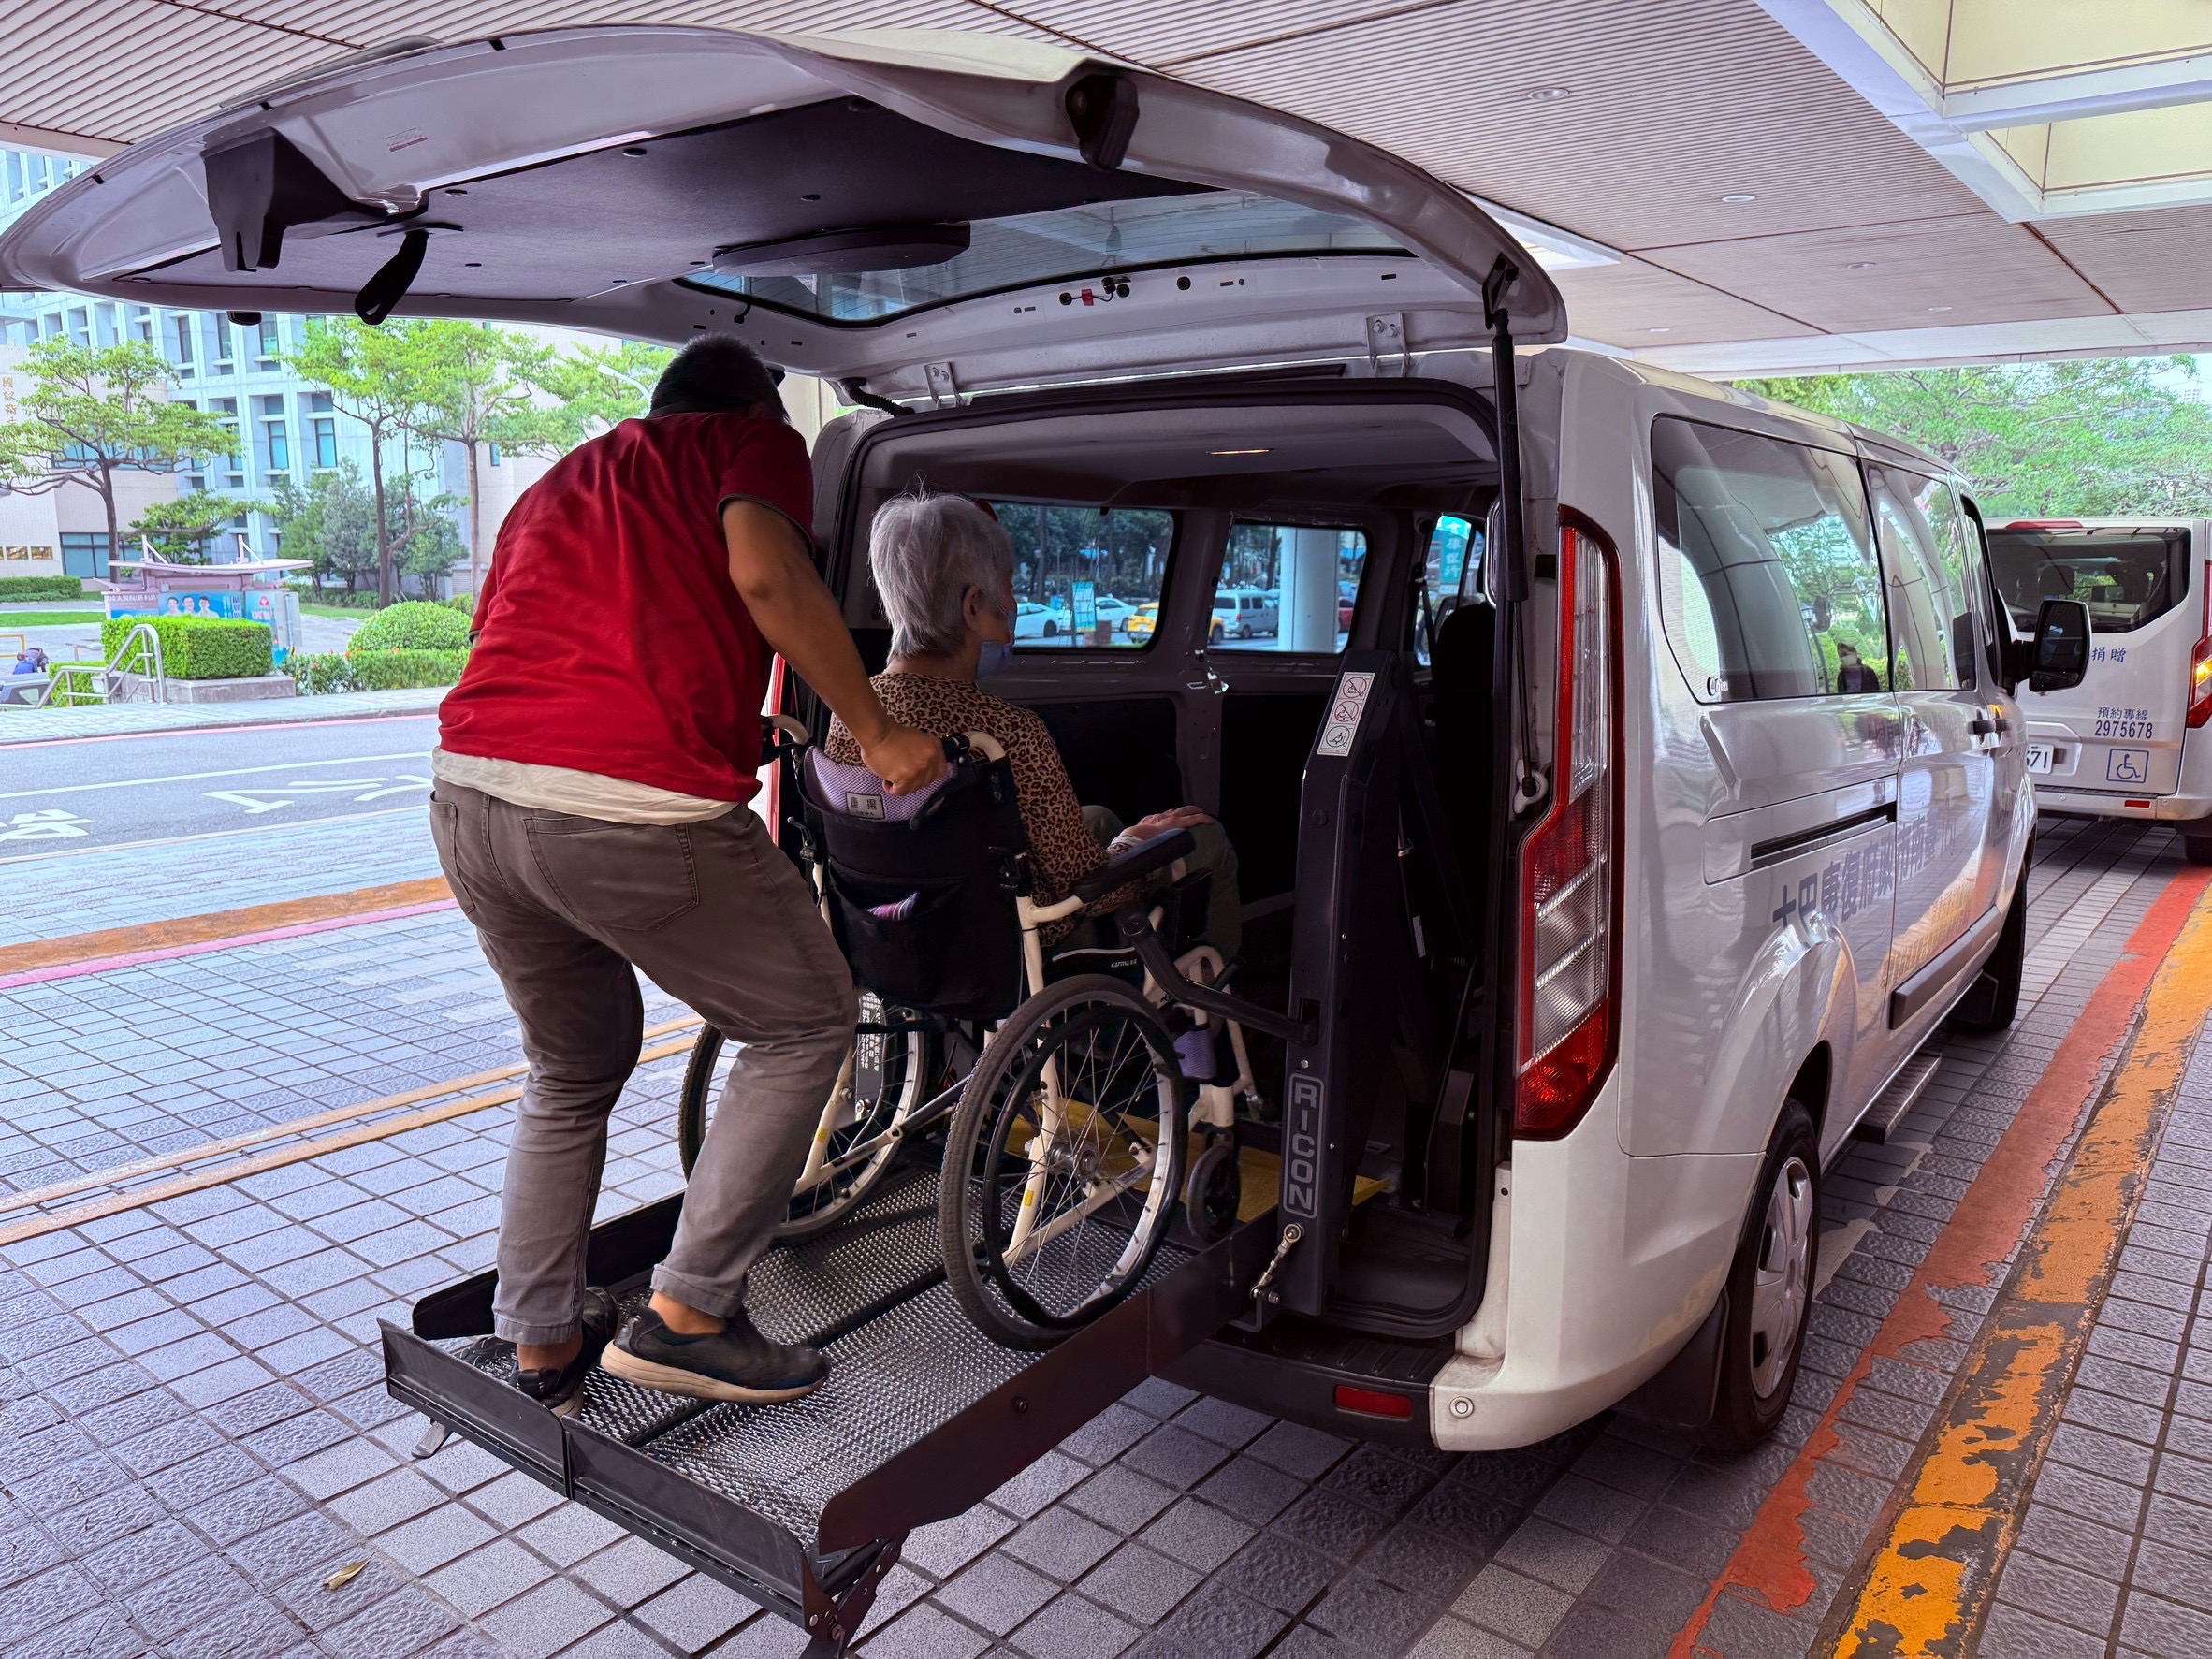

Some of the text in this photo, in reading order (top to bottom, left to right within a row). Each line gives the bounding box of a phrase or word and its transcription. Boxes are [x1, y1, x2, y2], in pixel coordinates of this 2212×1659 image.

[2091, 647, 2127, 662] 捐贈
[2097, 707, 2149, 721] 預約專線
[2094, 720, 2153, 740] 2975678
[1288, 1082, 1317, 1211] RICON
